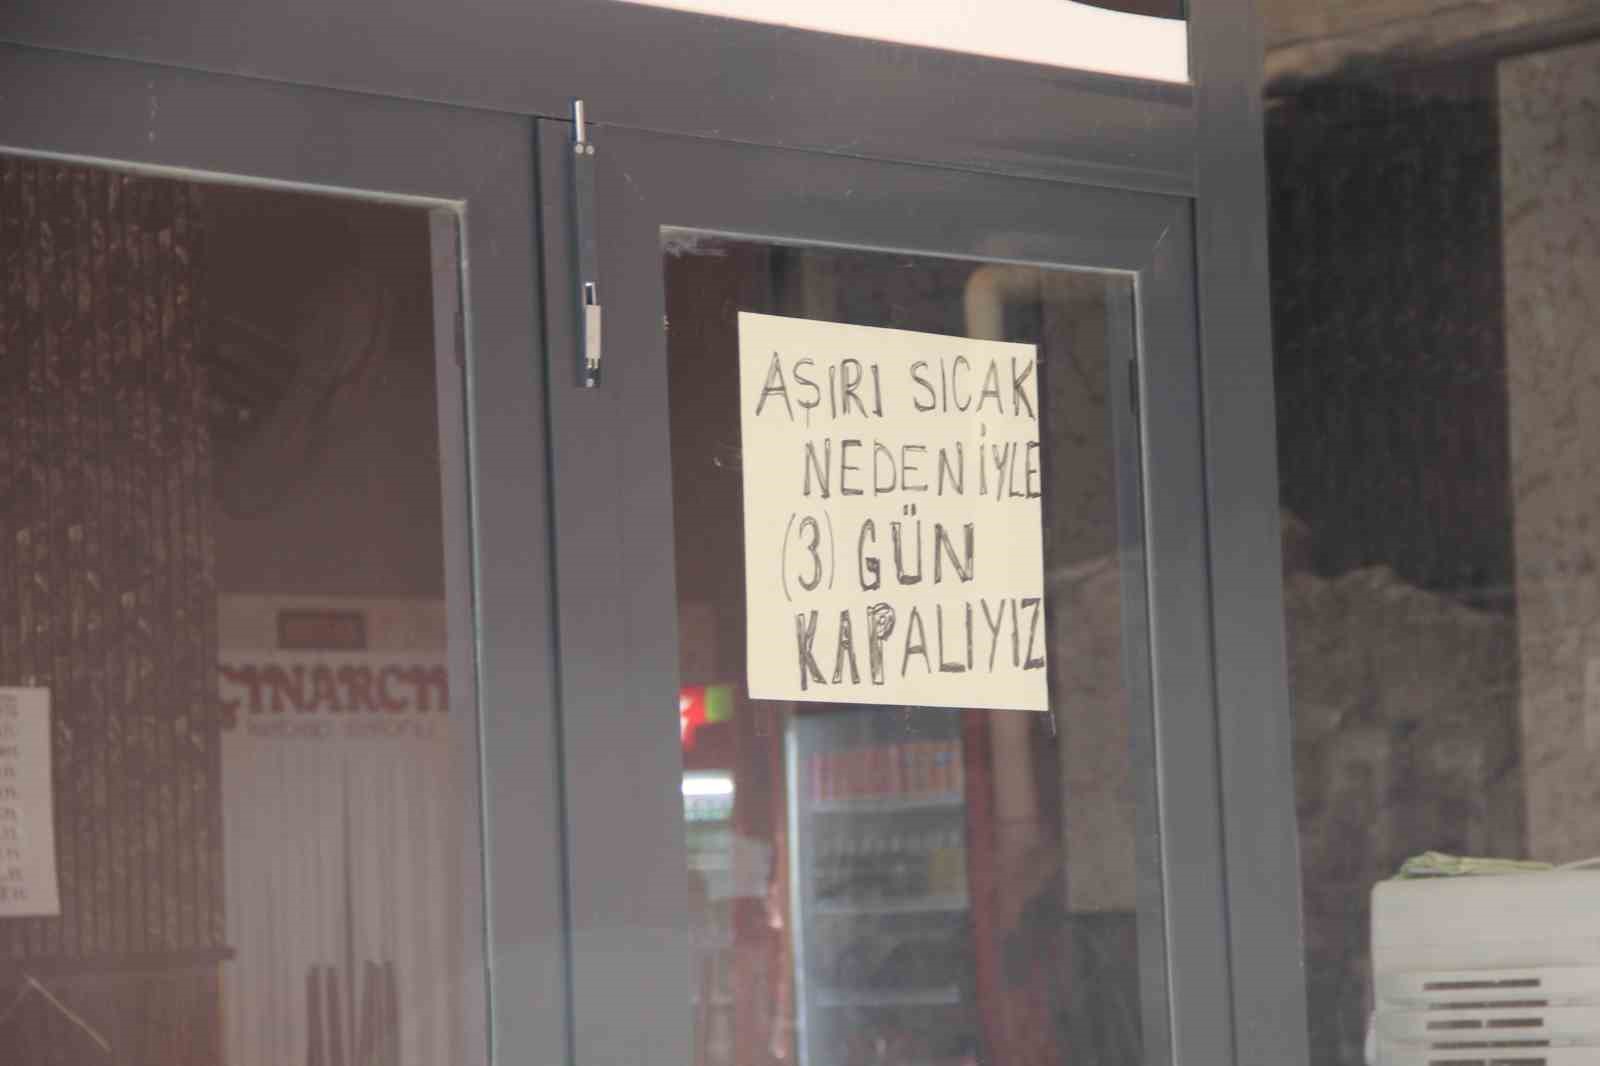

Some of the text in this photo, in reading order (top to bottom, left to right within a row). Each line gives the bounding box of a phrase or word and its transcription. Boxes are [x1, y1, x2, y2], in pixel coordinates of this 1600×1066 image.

[756, 352, 1036, 428] AŞIRI SICAK
[803, 423, 1042, 502] NEDENİYLE
[782, 504, 975, 602] (3) GÜN
[795, 598, 1045, 691] KAPALIYIZ
